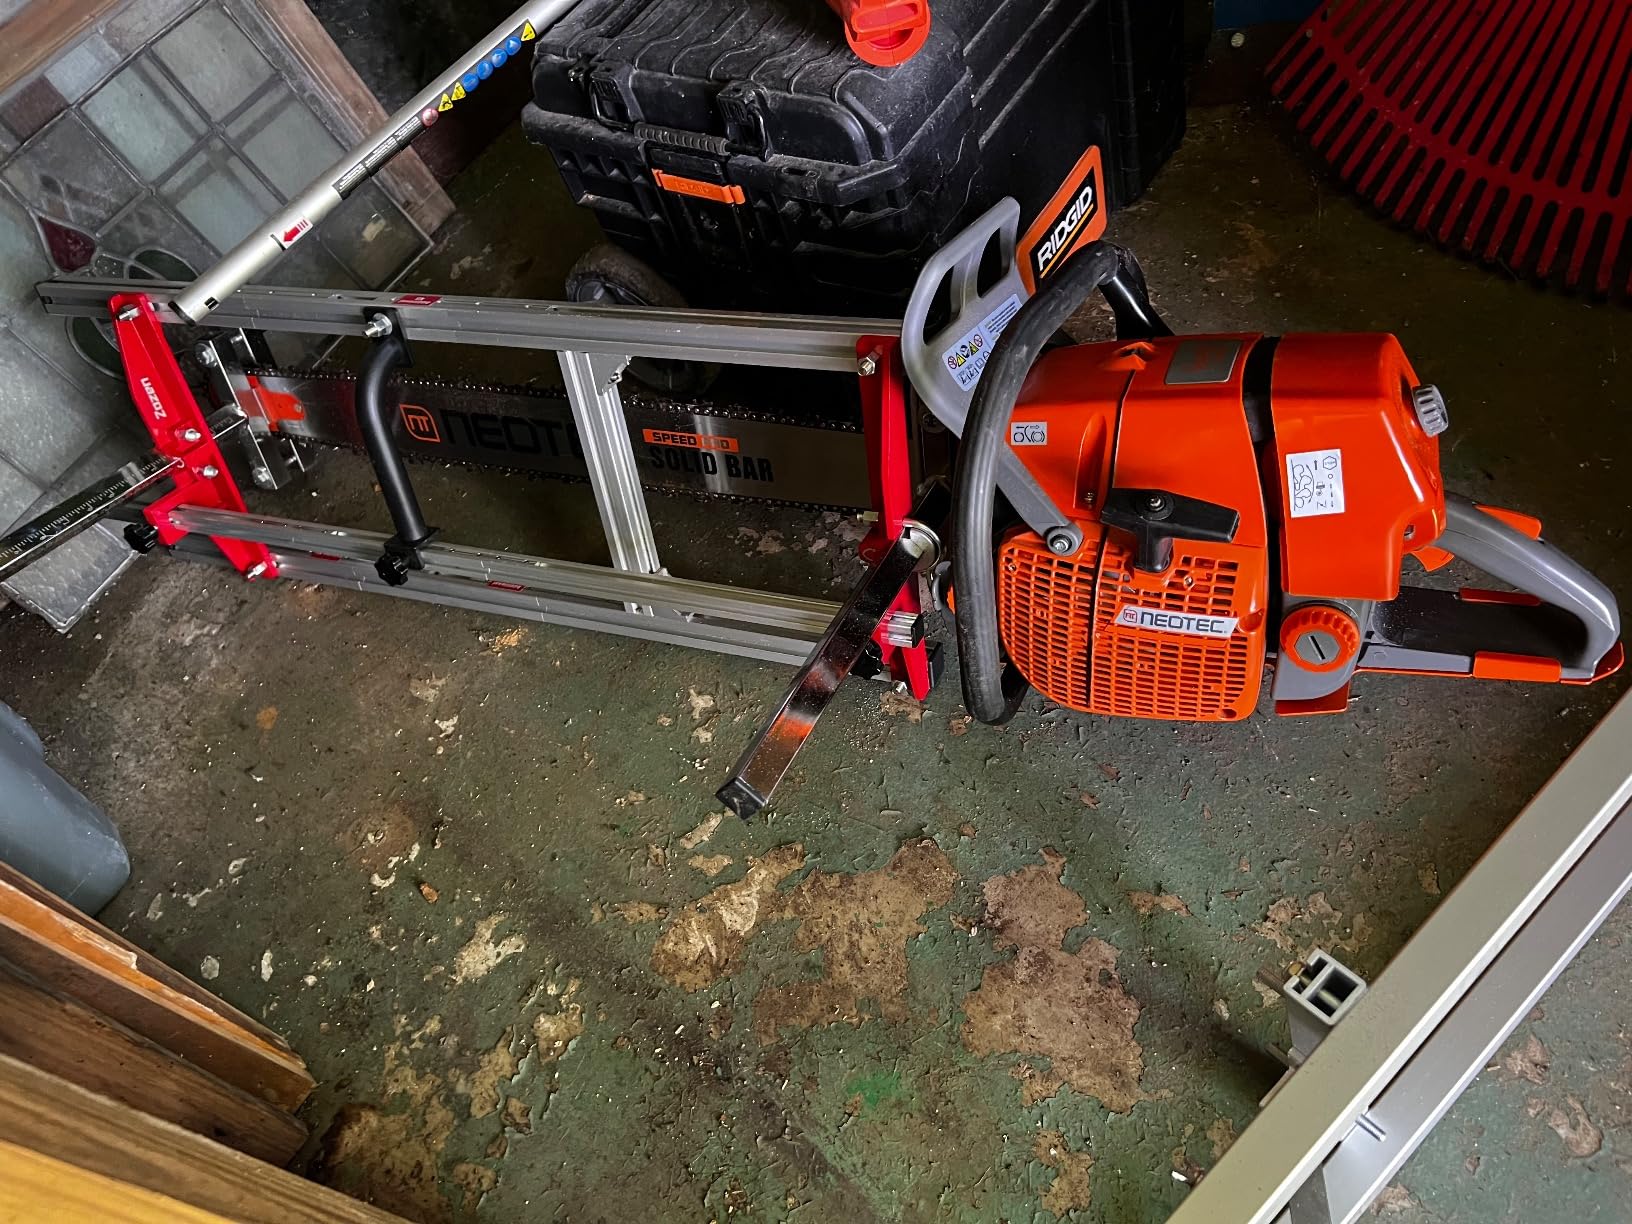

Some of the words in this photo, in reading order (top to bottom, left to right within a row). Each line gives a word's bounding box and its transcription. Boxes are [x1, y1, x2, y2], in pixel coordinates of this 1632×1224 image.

[1037, 186, 1093, 271] RIDGID
[652, 431, 697, 446] SPEED
[649, 445, 718, 475] SOLID
[725, 454, 774, 482] BAR
[1140, 611, 1225, 634] NEOTEC
